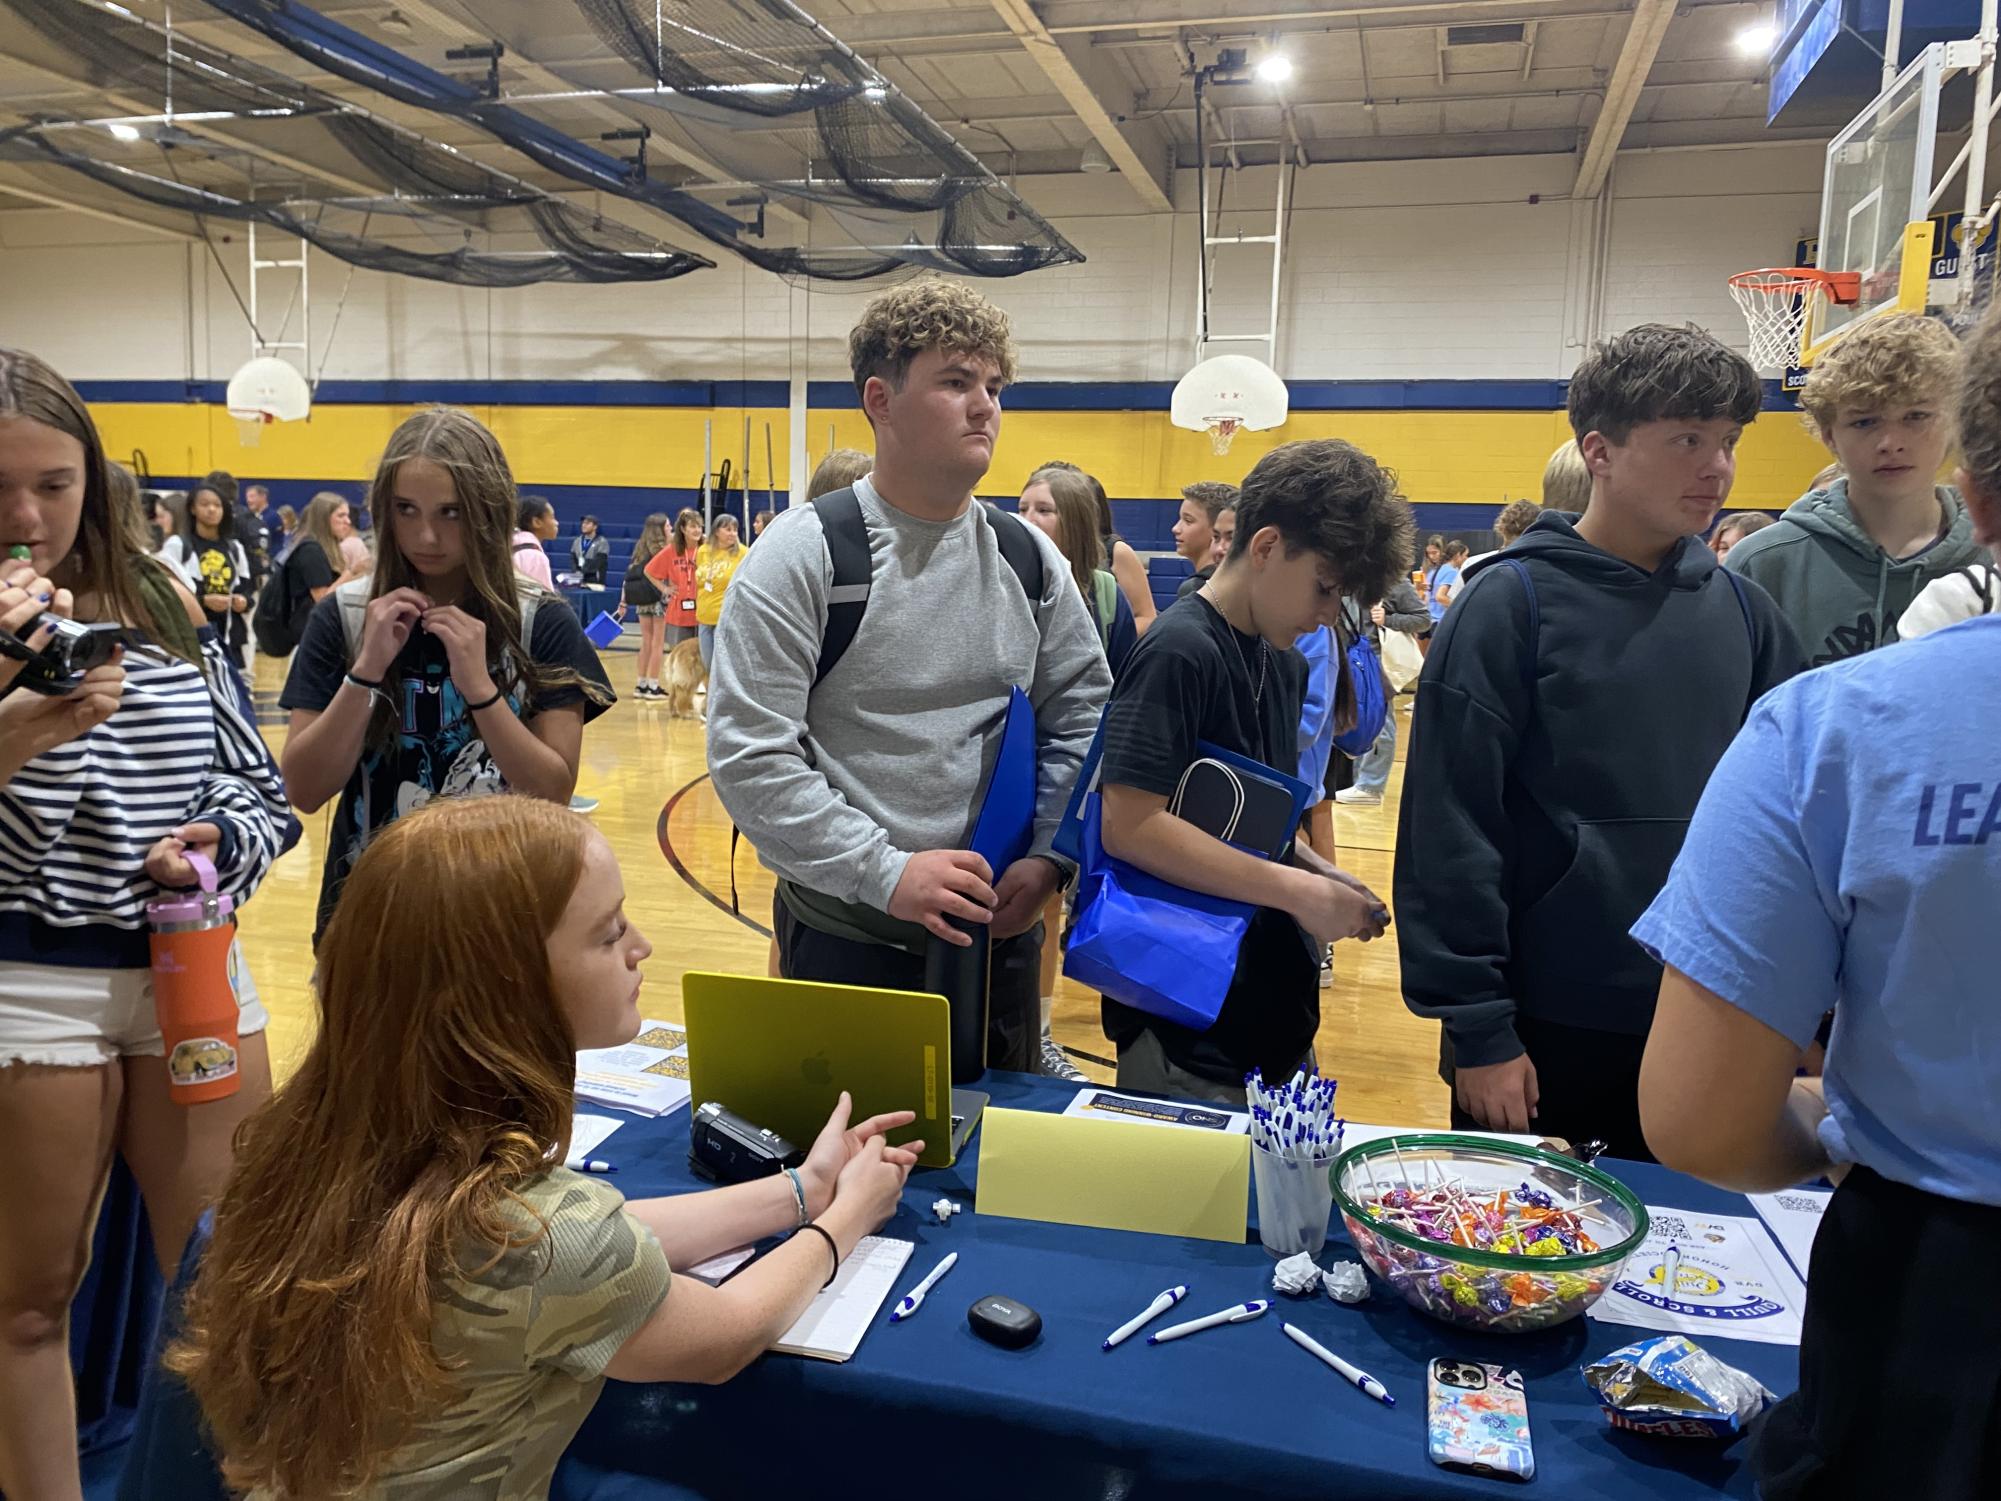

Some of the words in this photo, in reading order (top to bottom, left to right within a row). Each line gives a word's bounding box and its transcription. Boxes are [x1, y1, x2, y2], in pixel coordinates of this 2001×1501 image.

[1935, 253, 1988, 276] GUT
[1704, 1307, 1717, 1317] &
[1724, 1300, 1779, 1317] QUILL
